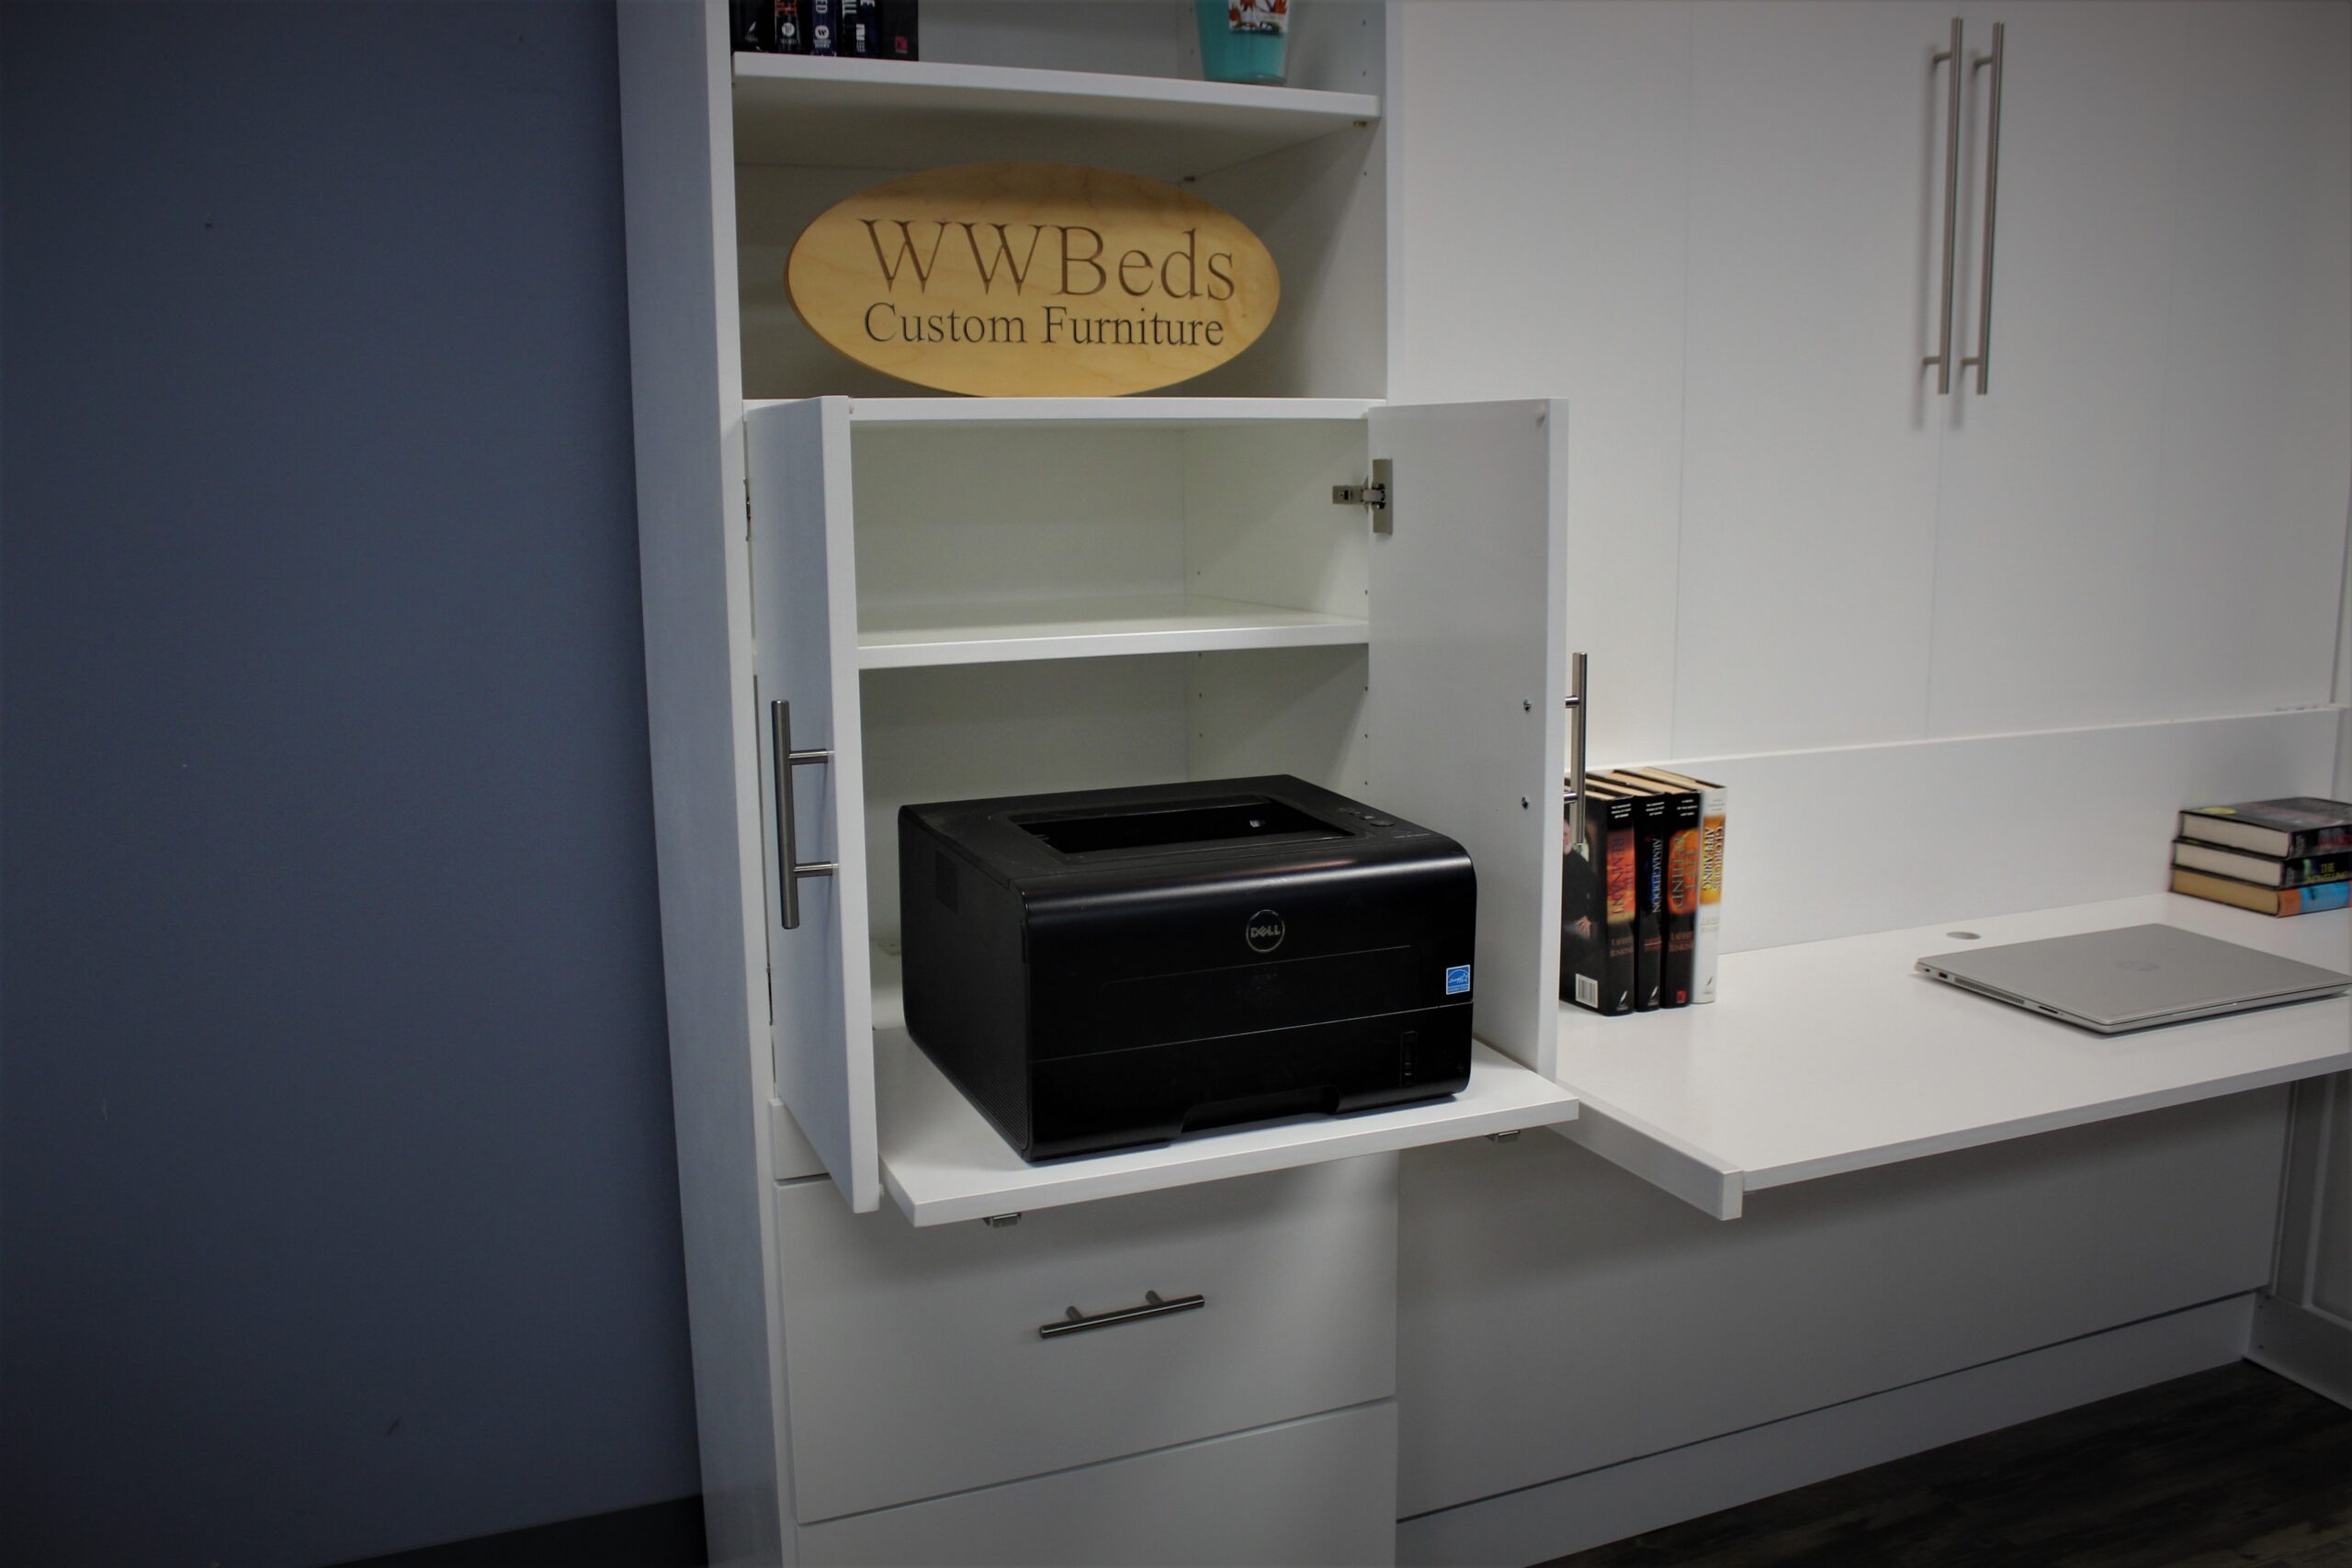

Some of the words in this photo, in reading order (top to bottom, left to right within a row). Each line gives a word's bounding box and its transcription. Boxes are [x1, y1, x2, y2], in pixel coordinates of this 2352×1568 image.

[858, 219, 1235, 301] WWBeds
[864, 302, 1027, 344] Custom
[1041, 305, 1224, 347] Furniture
[1651, 838, 1662, 914] ARMAGEDDON
[1250, 924, 1281, 939] DELL
